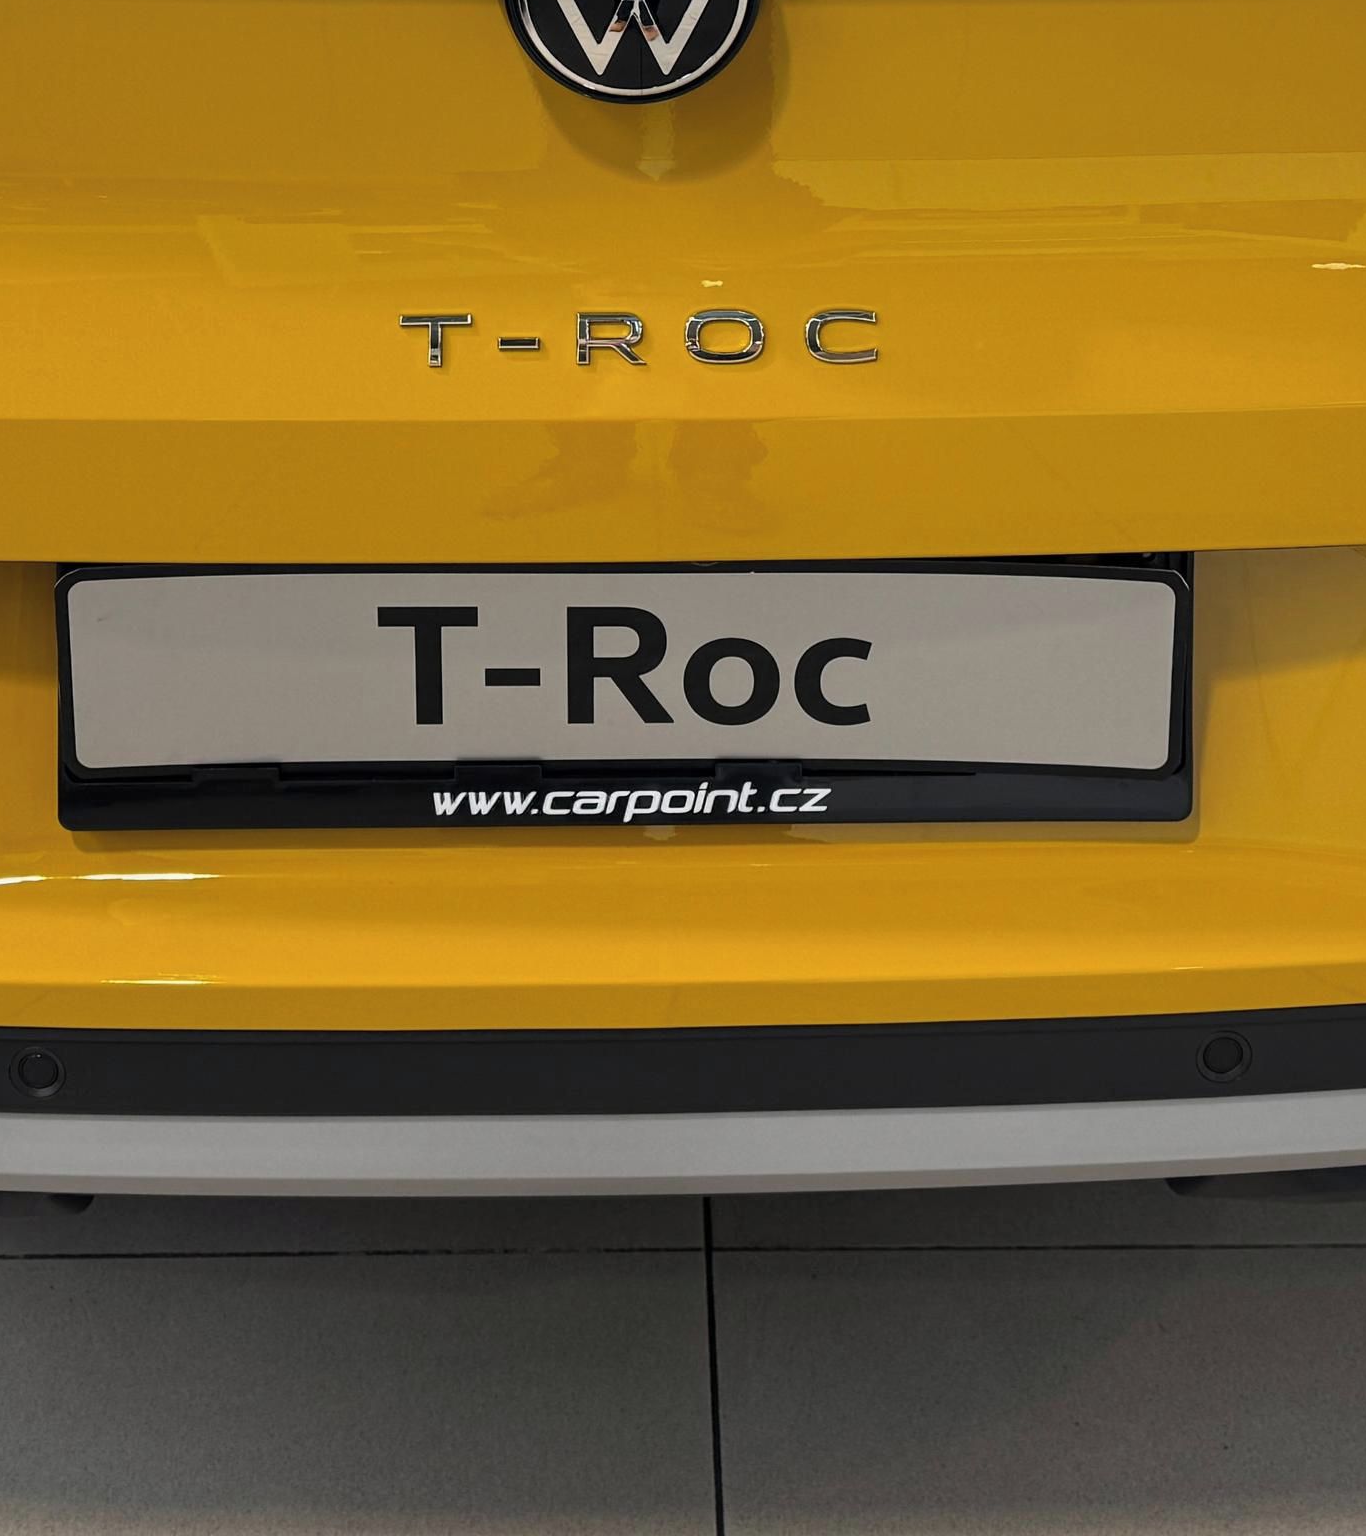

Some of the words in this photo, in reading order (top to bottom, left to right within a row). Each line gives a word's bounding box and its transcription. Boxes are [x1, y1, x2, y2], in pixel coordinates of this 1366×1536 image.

[399, 309, 880, 367] T-ROC
[376, 604, 872, 727] T-Roc
[432, 781, 833, 823] www.carpoint.cz
